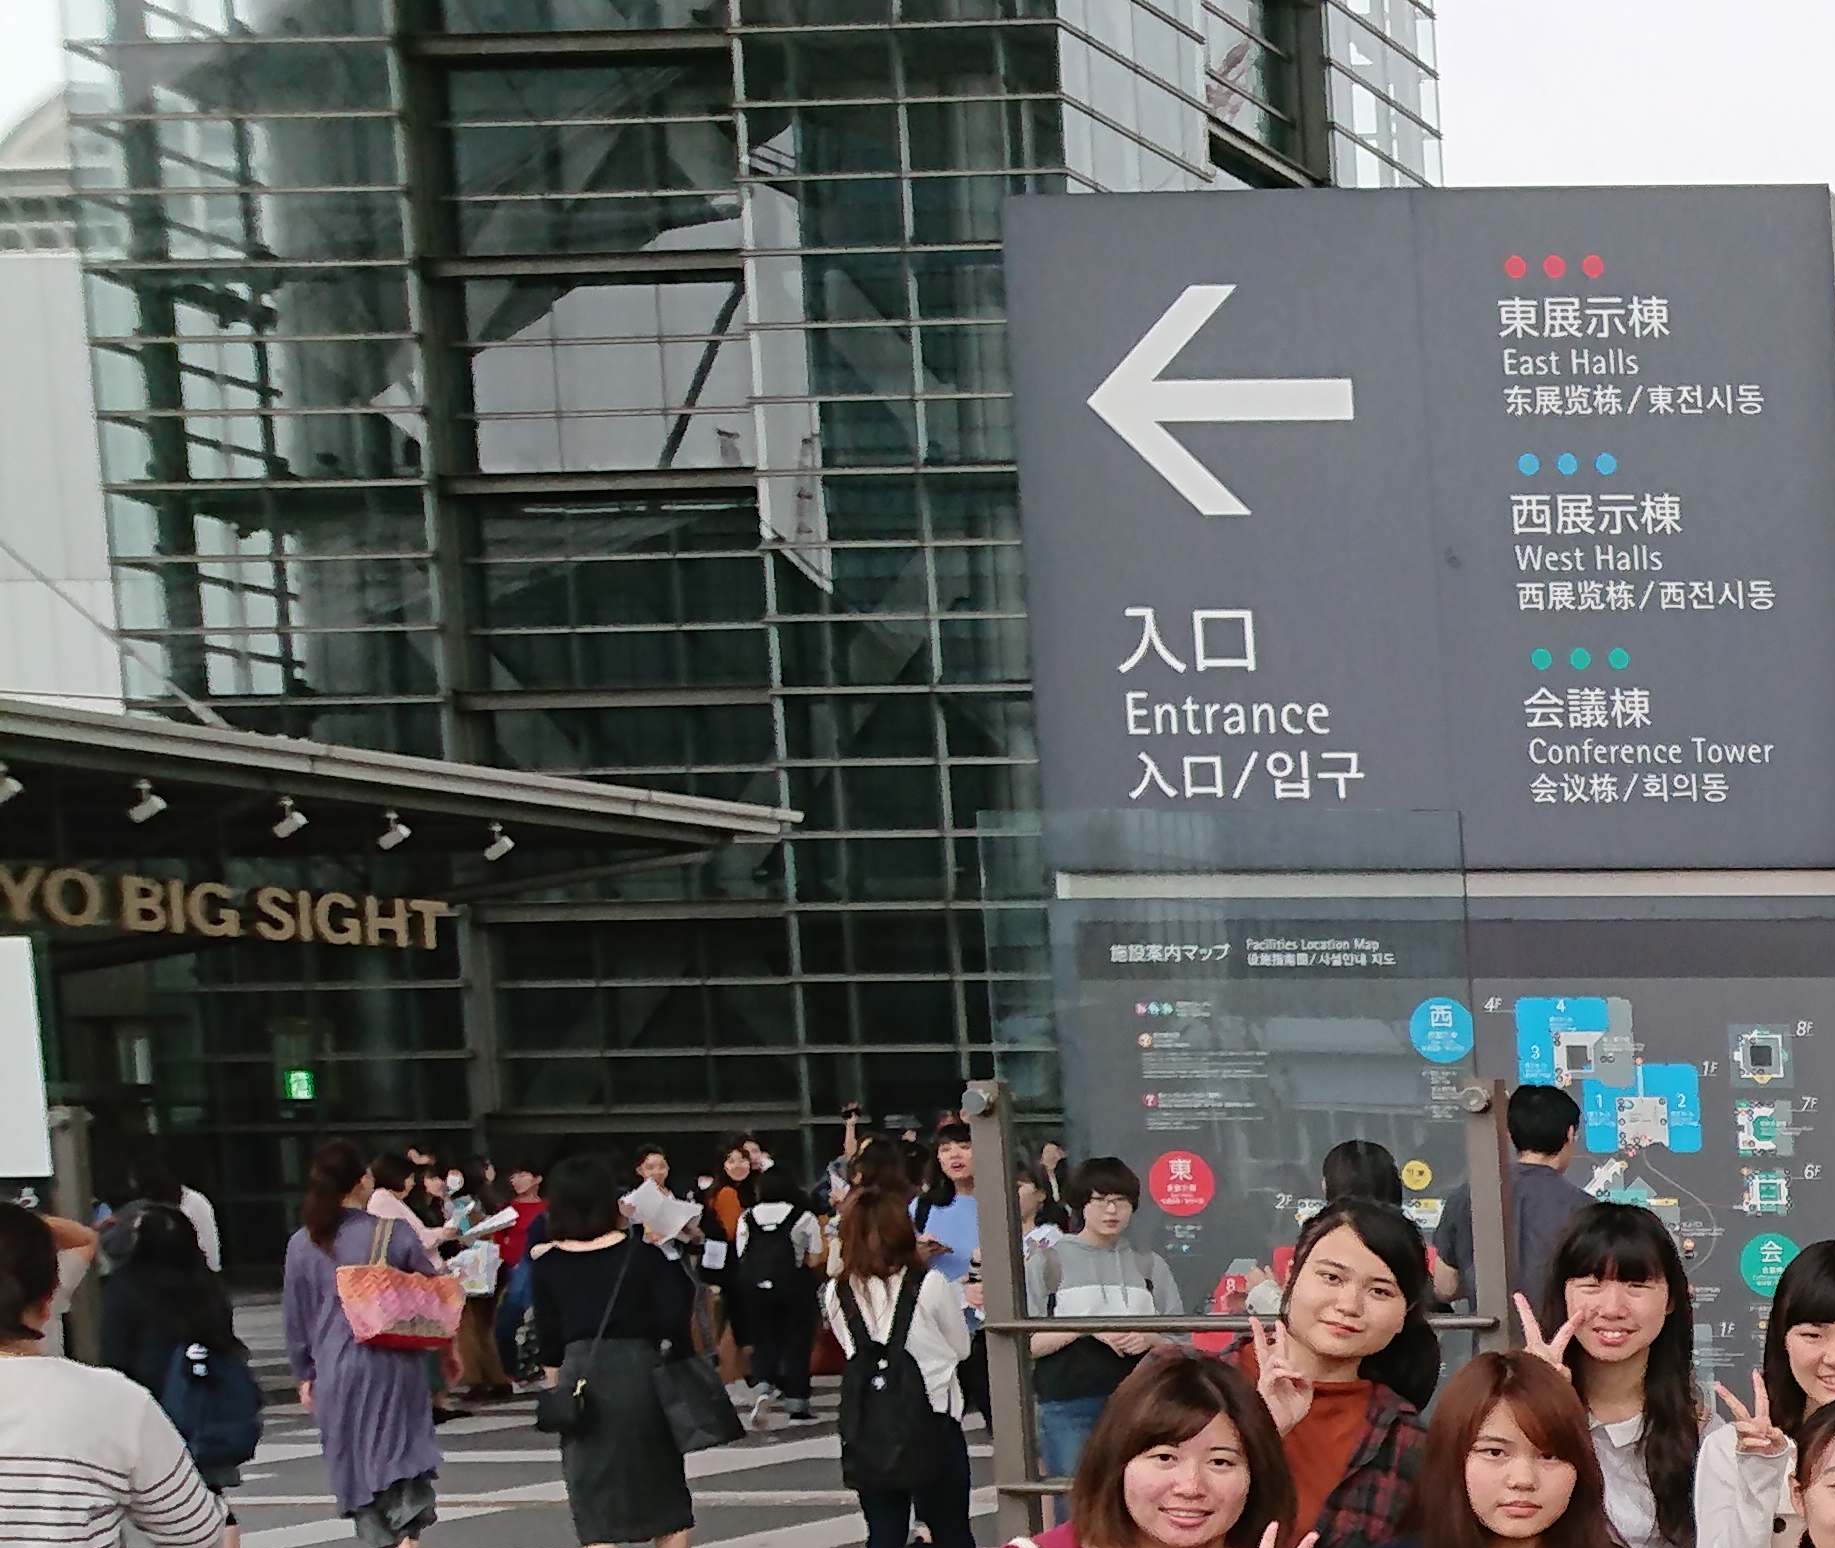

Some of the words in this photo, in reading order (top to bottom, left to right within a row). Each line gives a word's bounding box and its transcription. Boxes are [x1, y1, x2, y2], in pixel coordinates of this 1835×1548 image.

[1497, 295, 1671, 338] 東展示棟
[1502, 348, 1561, 375] East
[1570, 348, 1641, 375] Halls
[1509, 492, 1684, 535] 西展示棟
[1514, 544, 1586, 571] West
[1594, 544, 1664, 571] Halls
[1117, 606, 1257, 674] 入口
[1125, 690, 1331, 735] Entrance
[1523, 687, 1653, 729] 会議棟
[1528, 737, 1683, 764] Conference
[1690, 736, 1775, 764] Tower
[119, 872, 243, 939] BIG
[255, 886, 449, 950] SIGHT
[1246, 938, 1299, 950] Facilities
[1300, 938, 1350, 950] Location
[1353, 938, 1380, 952] Map
[1429, 1004, 1452, 1028] 西
[1168, 1158, 1193, 1181] 東
[1760, 1240, 1783, 1263] 会
